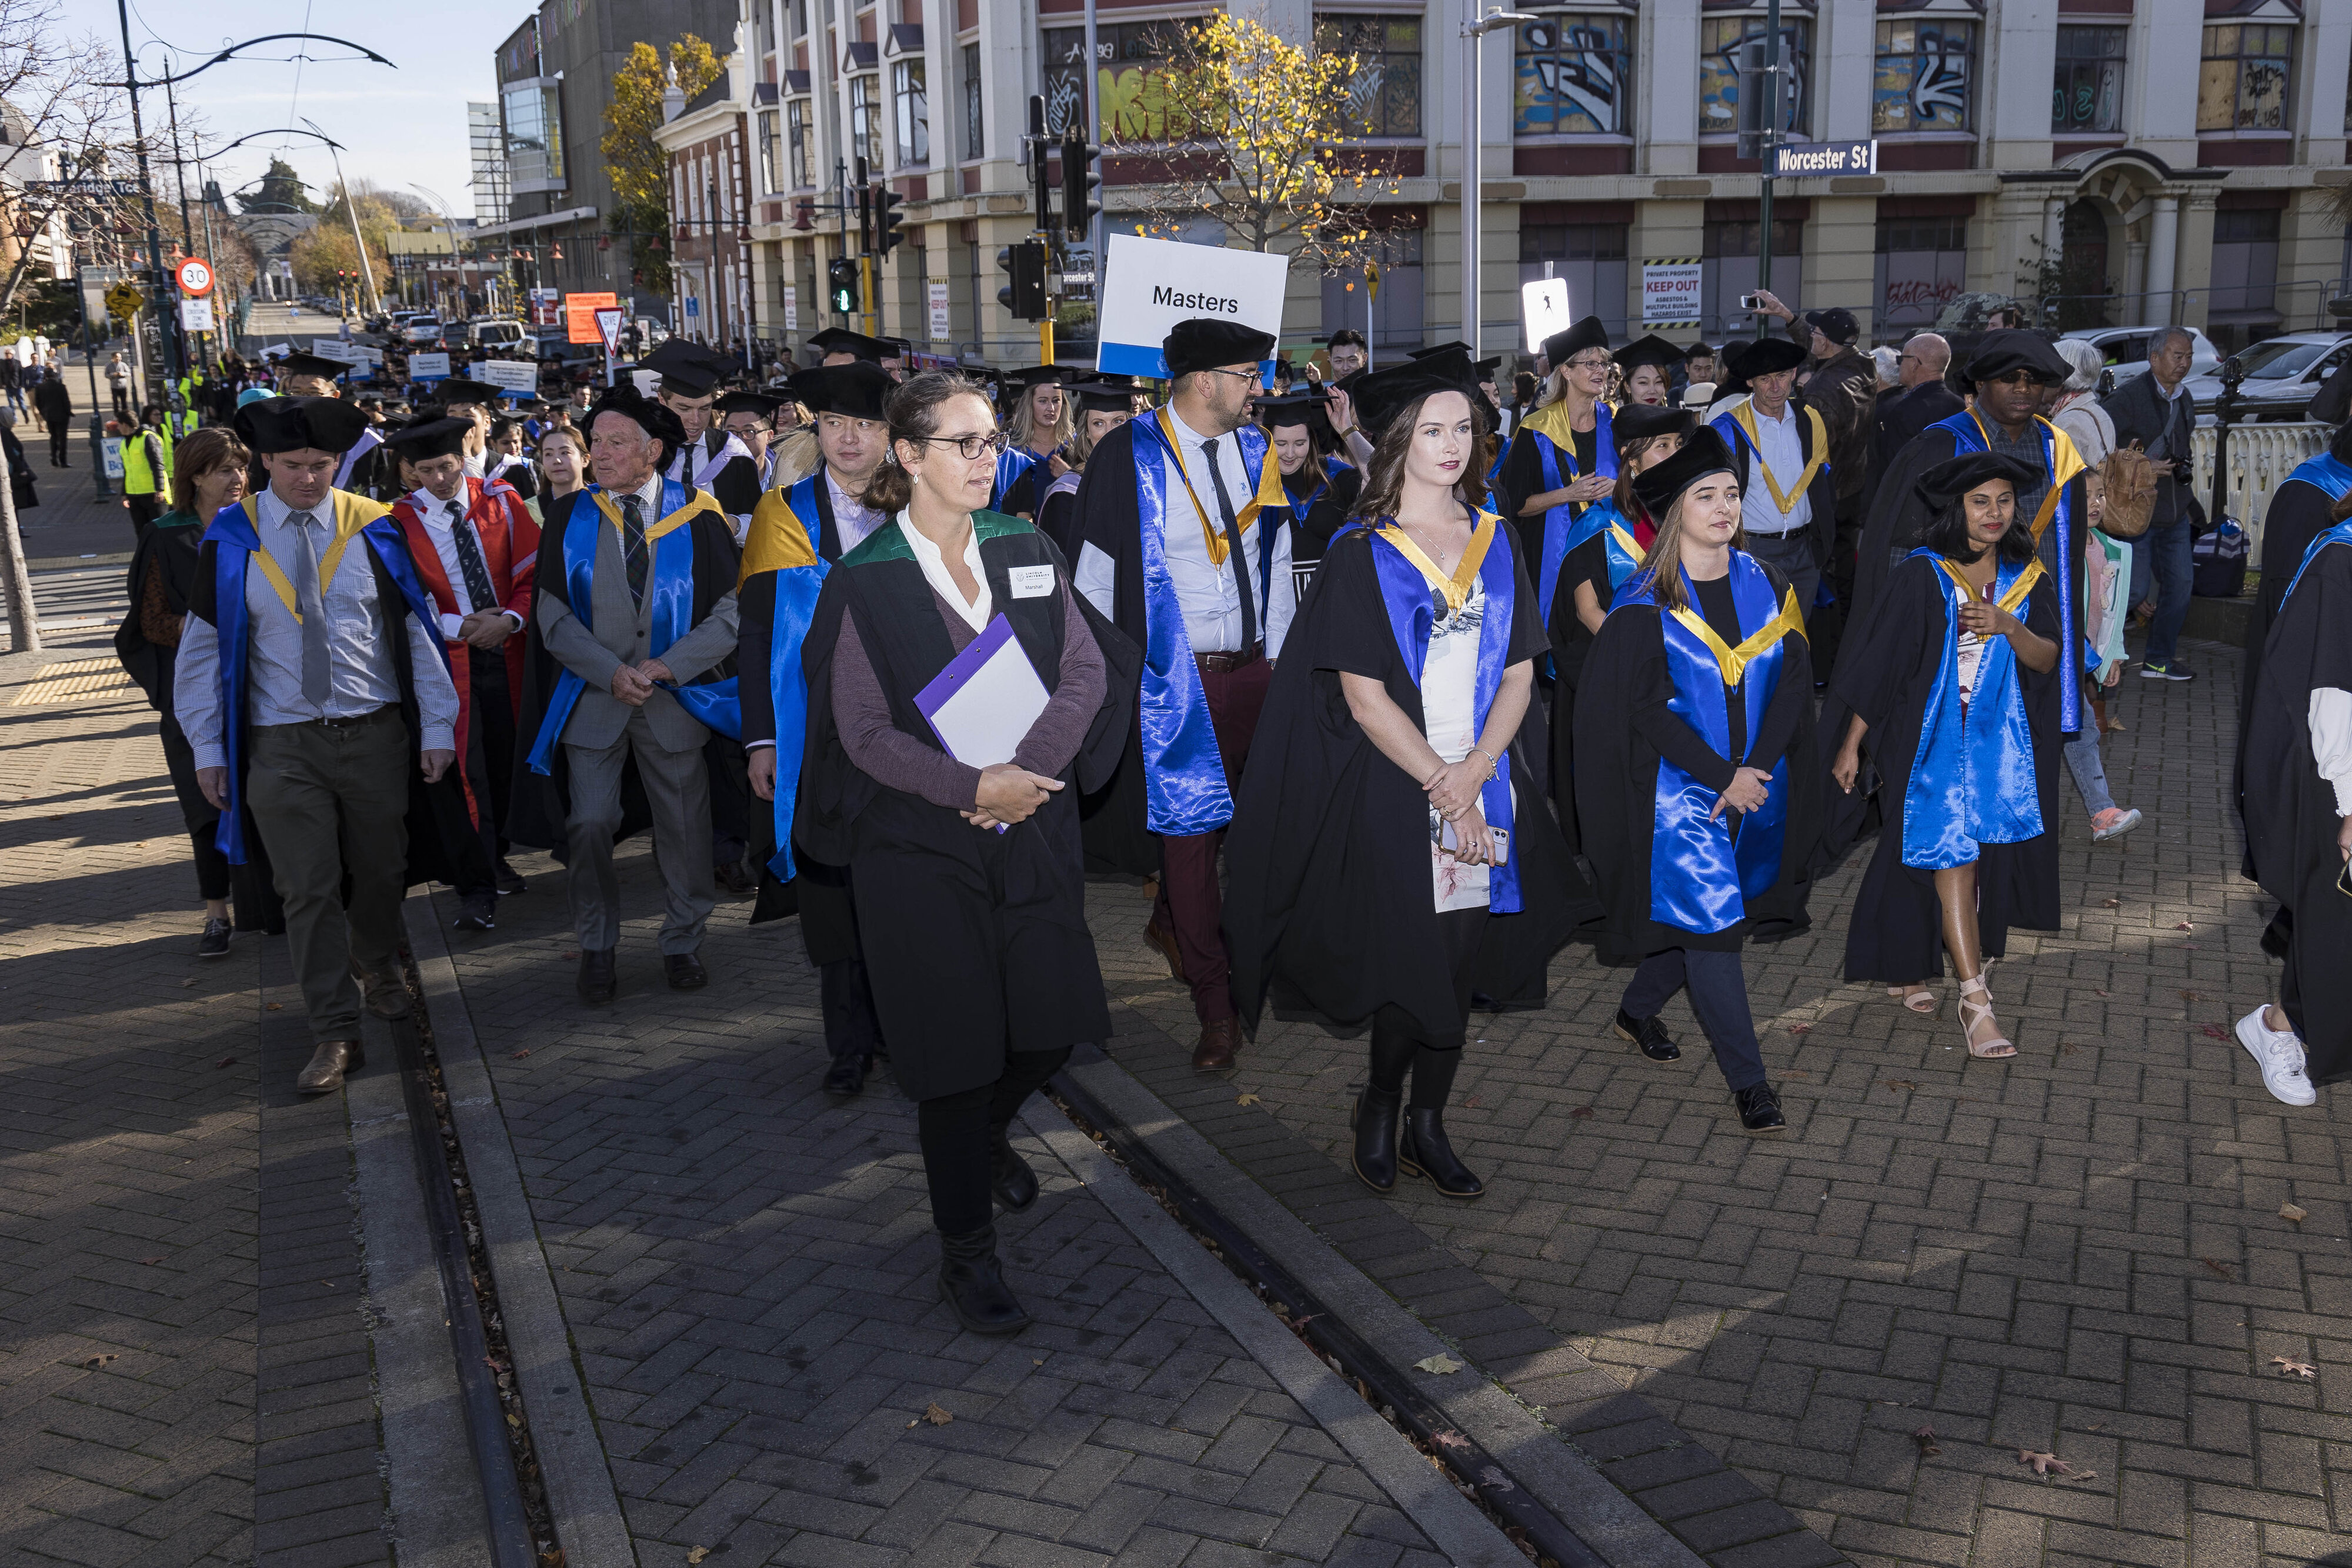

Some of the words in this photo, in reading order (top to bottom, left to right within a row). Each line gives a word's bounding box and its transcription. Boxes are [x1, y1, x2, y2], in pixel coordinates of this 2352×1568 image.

[1779, 147, 1846, 171] Worcester
[1851, 145, 1868, 169] St
[116, 181, 141, 193] Tce
[186, 270, 206, 283] 30
[1063, 273, 1087, 282] orcester
[1087, 272, 1095, 282] St
[1647, 281, 1674, 292] KEEP
[1676, 280, 1699, 291] OUT
[1153, 285, 1238, 313] Masters
[603, 315, 616, 325] GIVE
